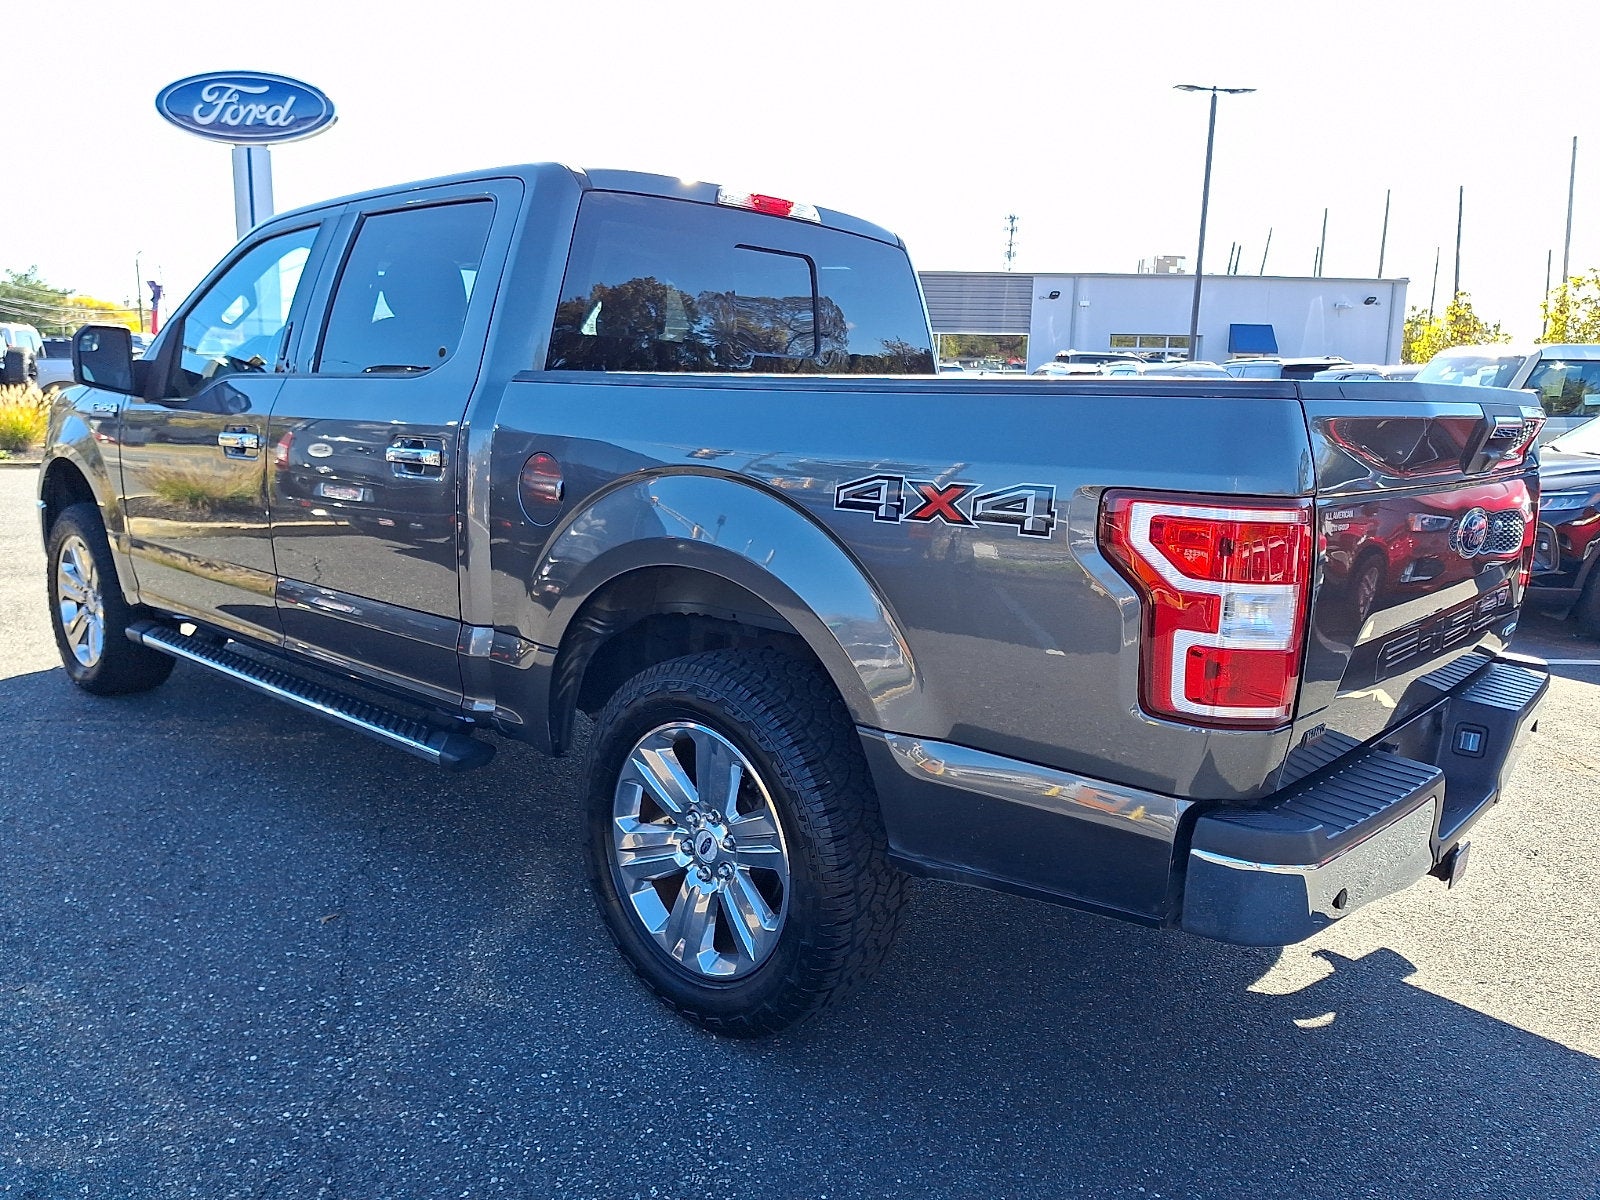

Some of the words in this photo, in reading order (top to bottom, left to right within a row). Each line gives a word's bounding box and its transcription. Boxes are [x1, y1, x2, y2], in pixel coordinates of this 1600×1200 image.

[193, 83, 296, 127] Ford
[833, 473, 1058, 540] 4X4
[1333, 510, 1353, 519] AMERICAN
